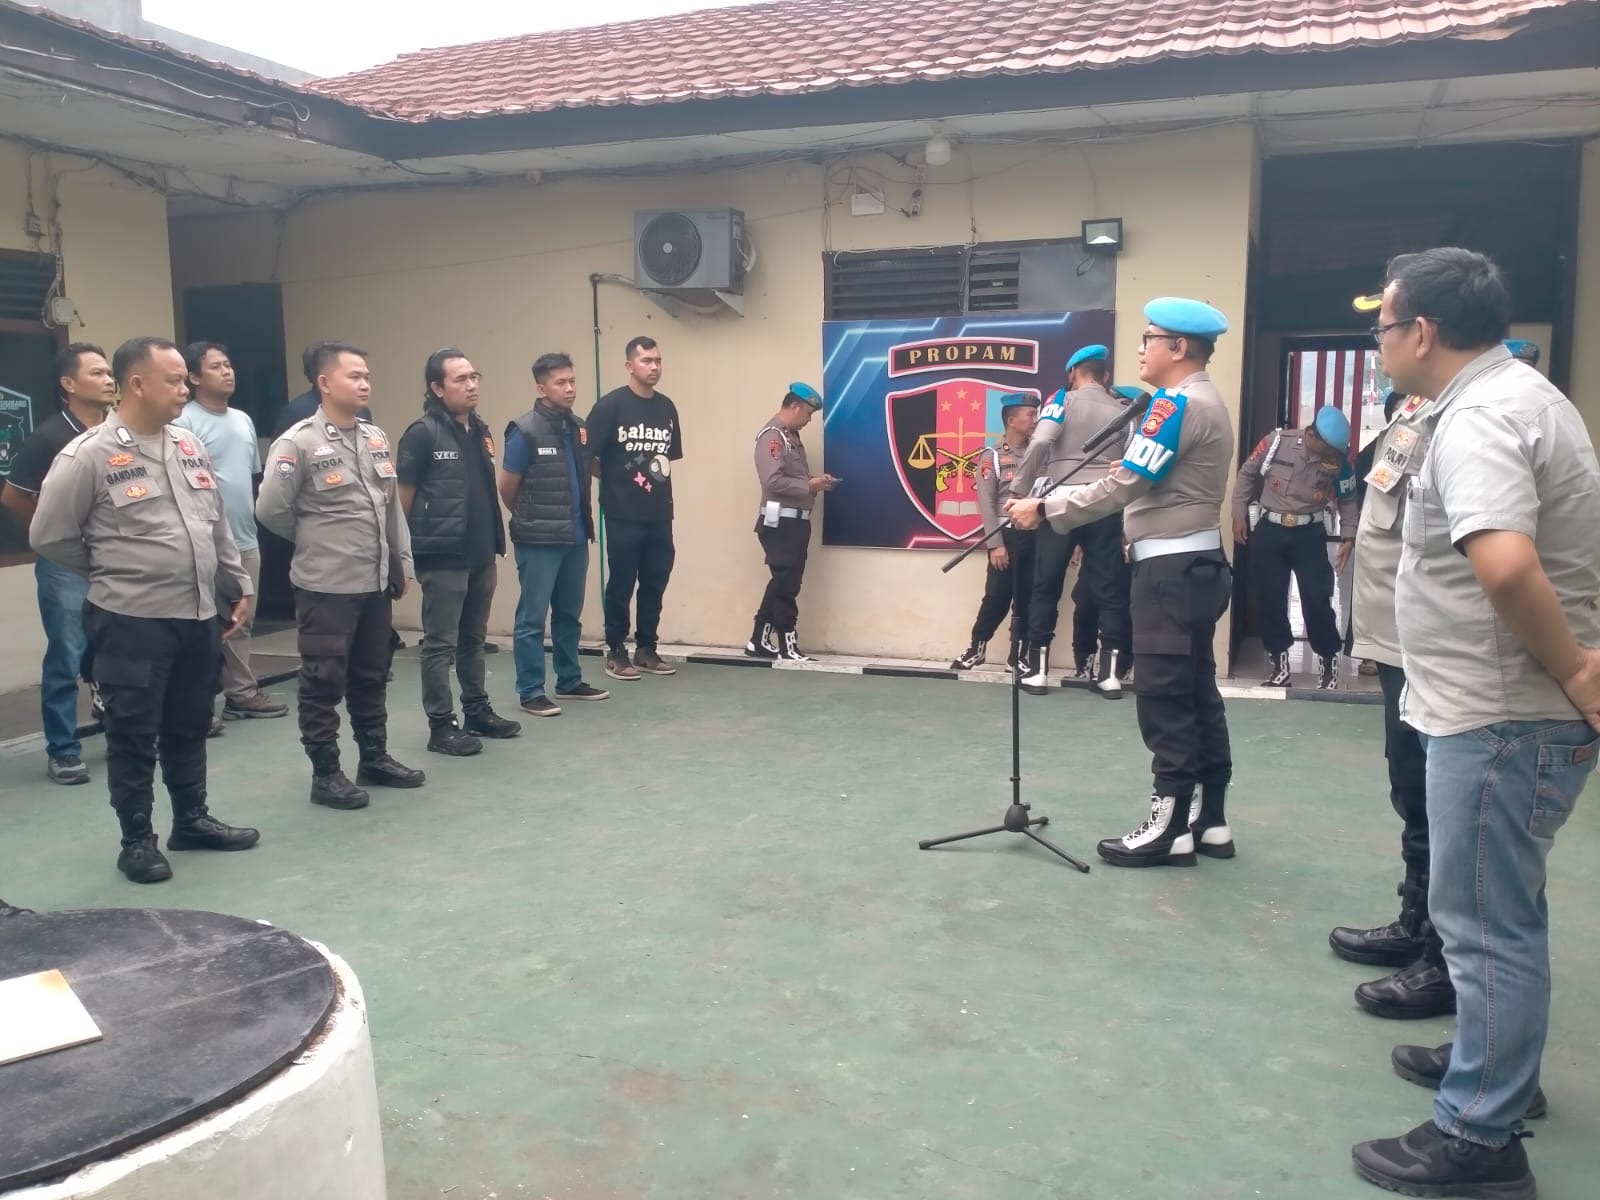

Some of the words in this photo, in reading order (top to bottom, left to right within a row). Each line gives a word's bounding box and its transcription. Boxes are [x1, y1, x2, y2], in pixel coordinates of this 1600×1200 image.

[909, 345, 1016, 365] PROPAM
[617, 423, 671, 443] balanc
[312, 457, 344, 471] YOGA
